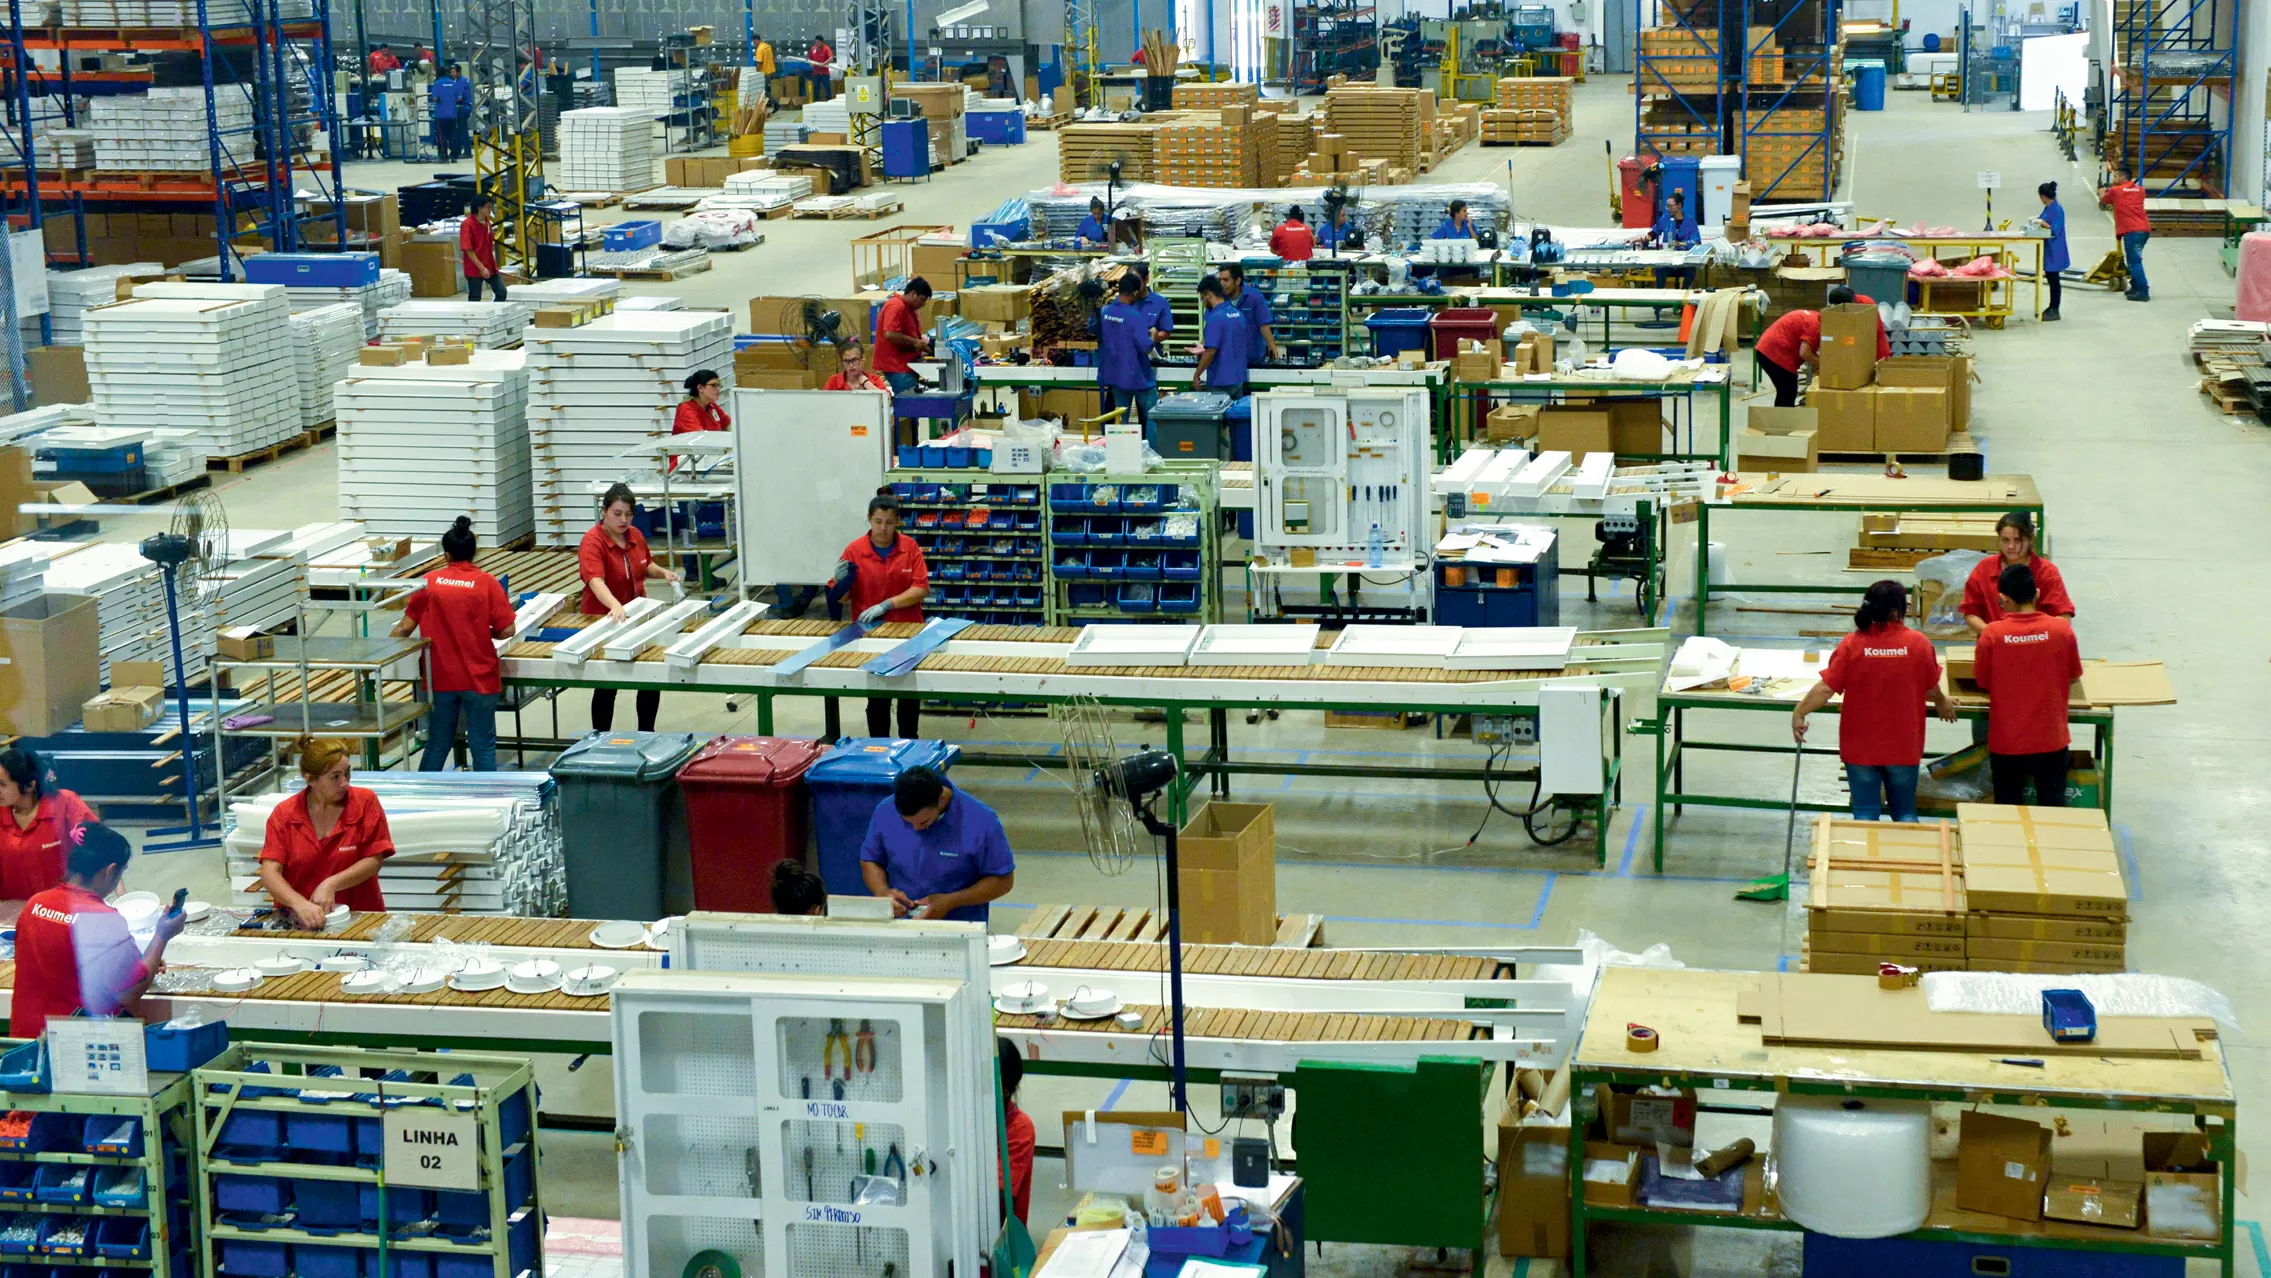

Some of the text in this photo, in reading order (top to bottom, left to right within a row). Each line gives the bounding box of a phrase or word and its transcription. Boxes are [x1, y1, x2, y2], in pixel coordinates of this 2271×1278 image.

[435, 576, 476, 589] Koumei
[2003, 631, 2049, 644] Koumei
[1863, 646, 1908, 657] Koumei
[31, 903, 79, 925] Koumei
[403, 1129, 458, 1146] LINHA
[420, 1155, 442, 1169] 02
